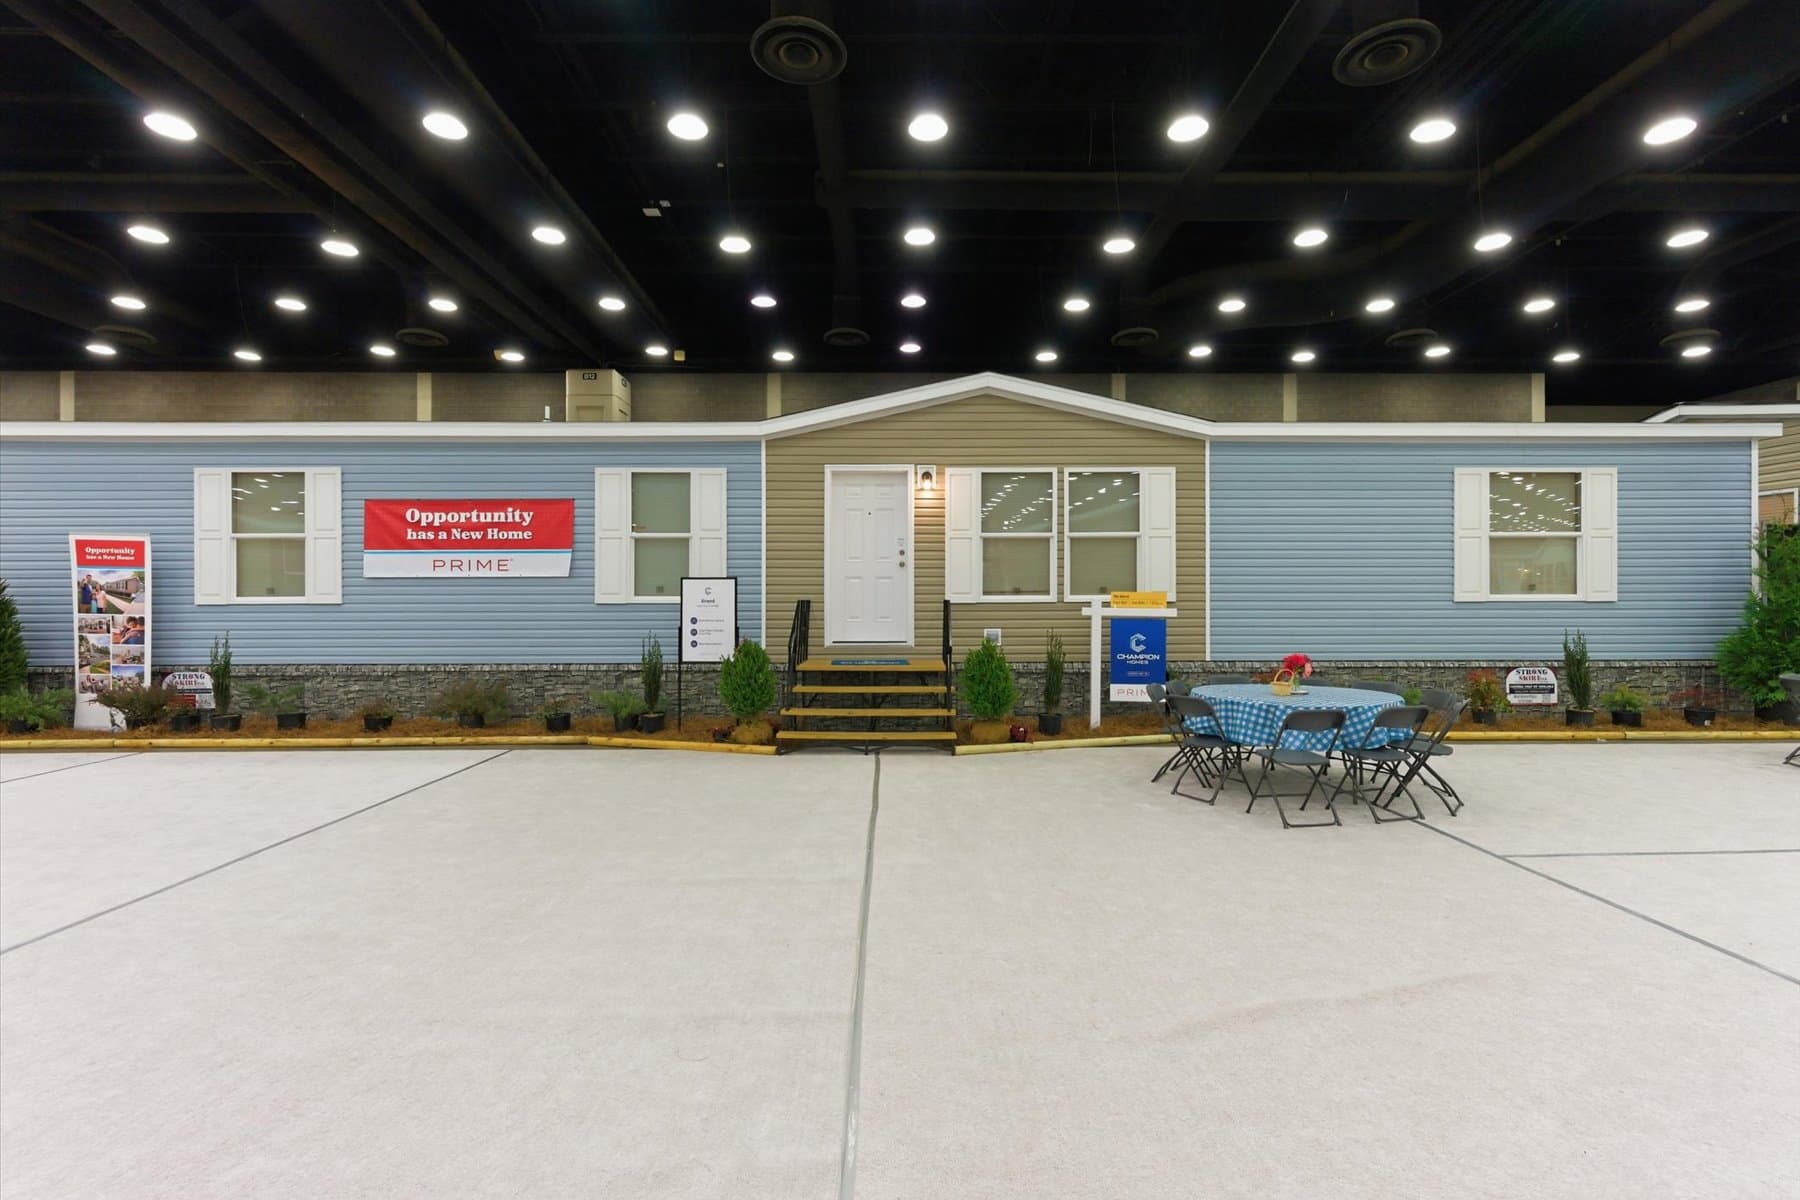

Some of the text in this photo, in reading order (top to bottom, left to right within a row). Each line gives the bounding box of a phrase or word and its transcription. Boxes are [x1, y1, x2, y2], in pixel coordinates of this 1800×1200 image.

[405, 507, 534, 527] Opportunity
[406, 528, 533, 540] has a New Home
[85, 546, 135, 555] Opportunity
[432, 559, 510, 572] PRIME
[1116, 688, 1147, 697] PRIM
